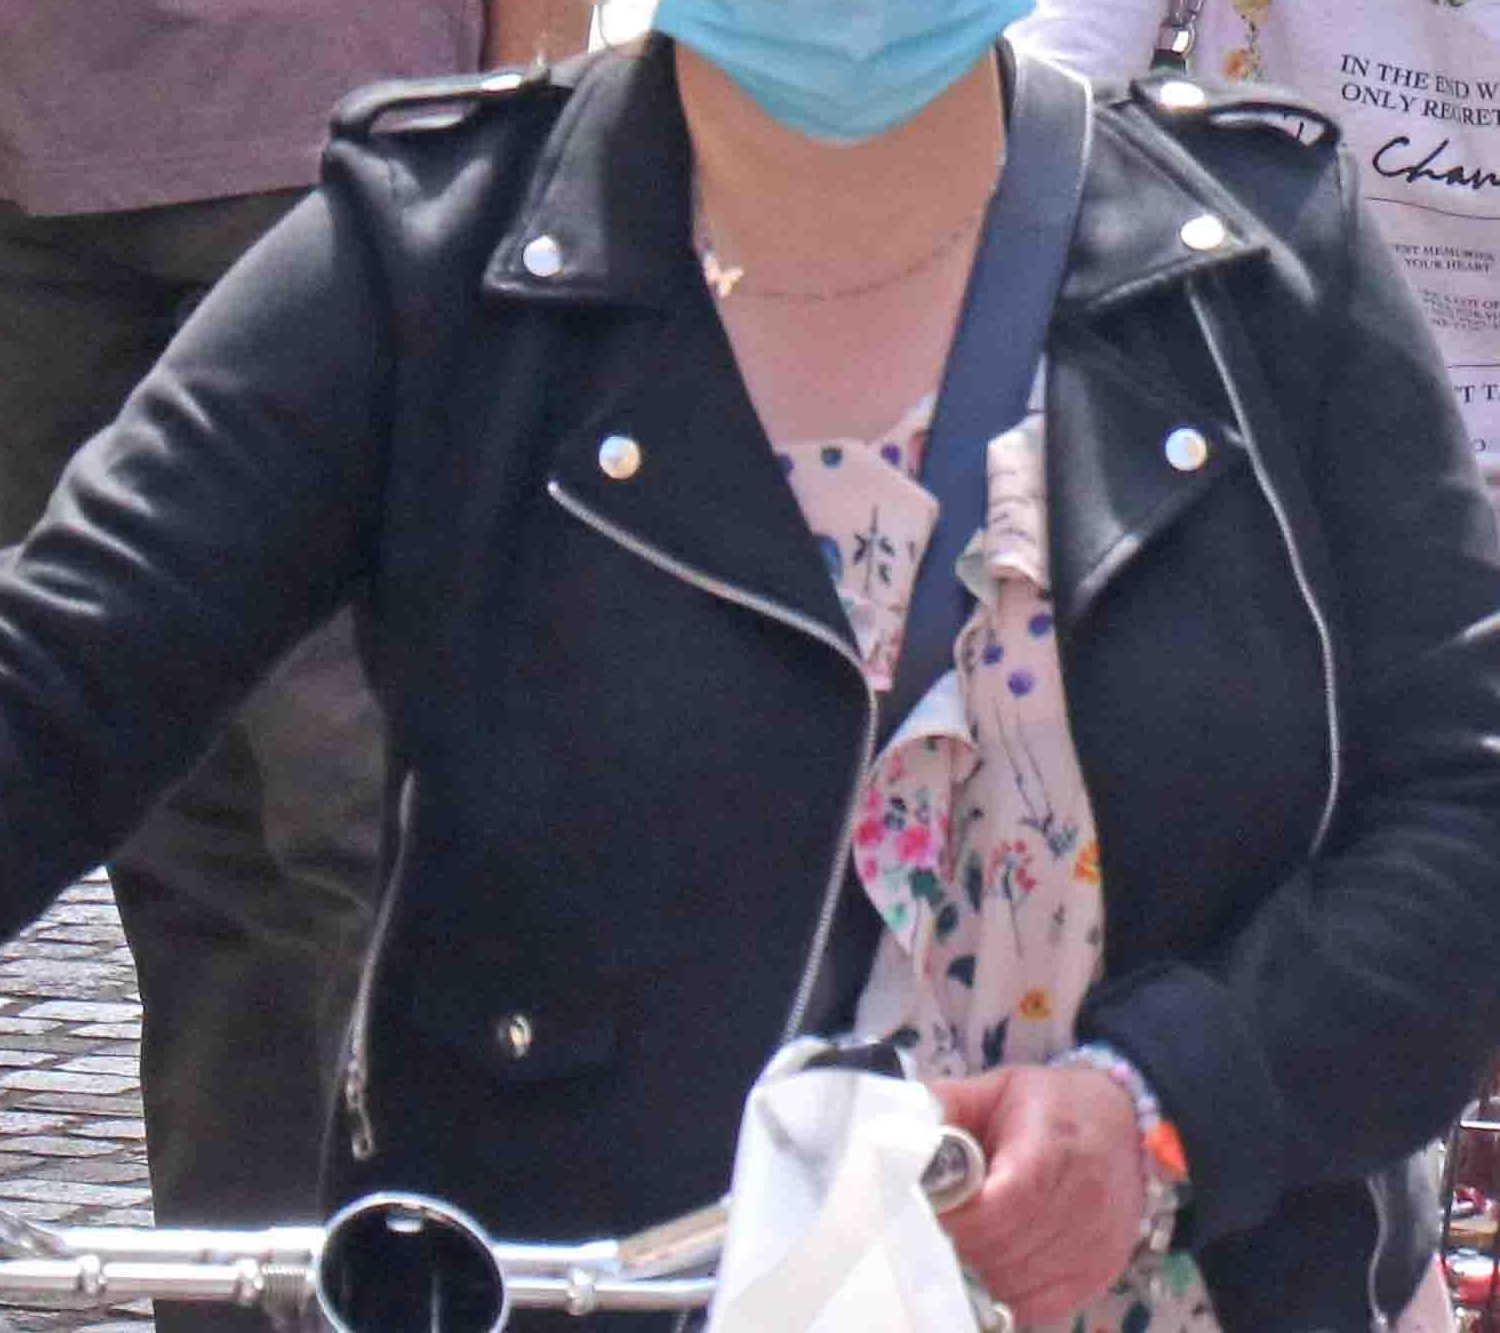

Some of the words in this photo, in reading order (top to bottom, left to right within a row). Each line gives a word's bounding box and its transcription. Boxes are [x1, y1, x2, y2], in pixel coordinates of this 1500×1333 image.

[1340, 53, 1370, 77] IN
[1377, 63, 1429, 92] THE
[1435, 73, 1470, 101] END
[1340, 83, 1416, 113] ONLY
[1404, 258, 1443, 270] YOUR
[1446, 260, 1491, 274] HEART
